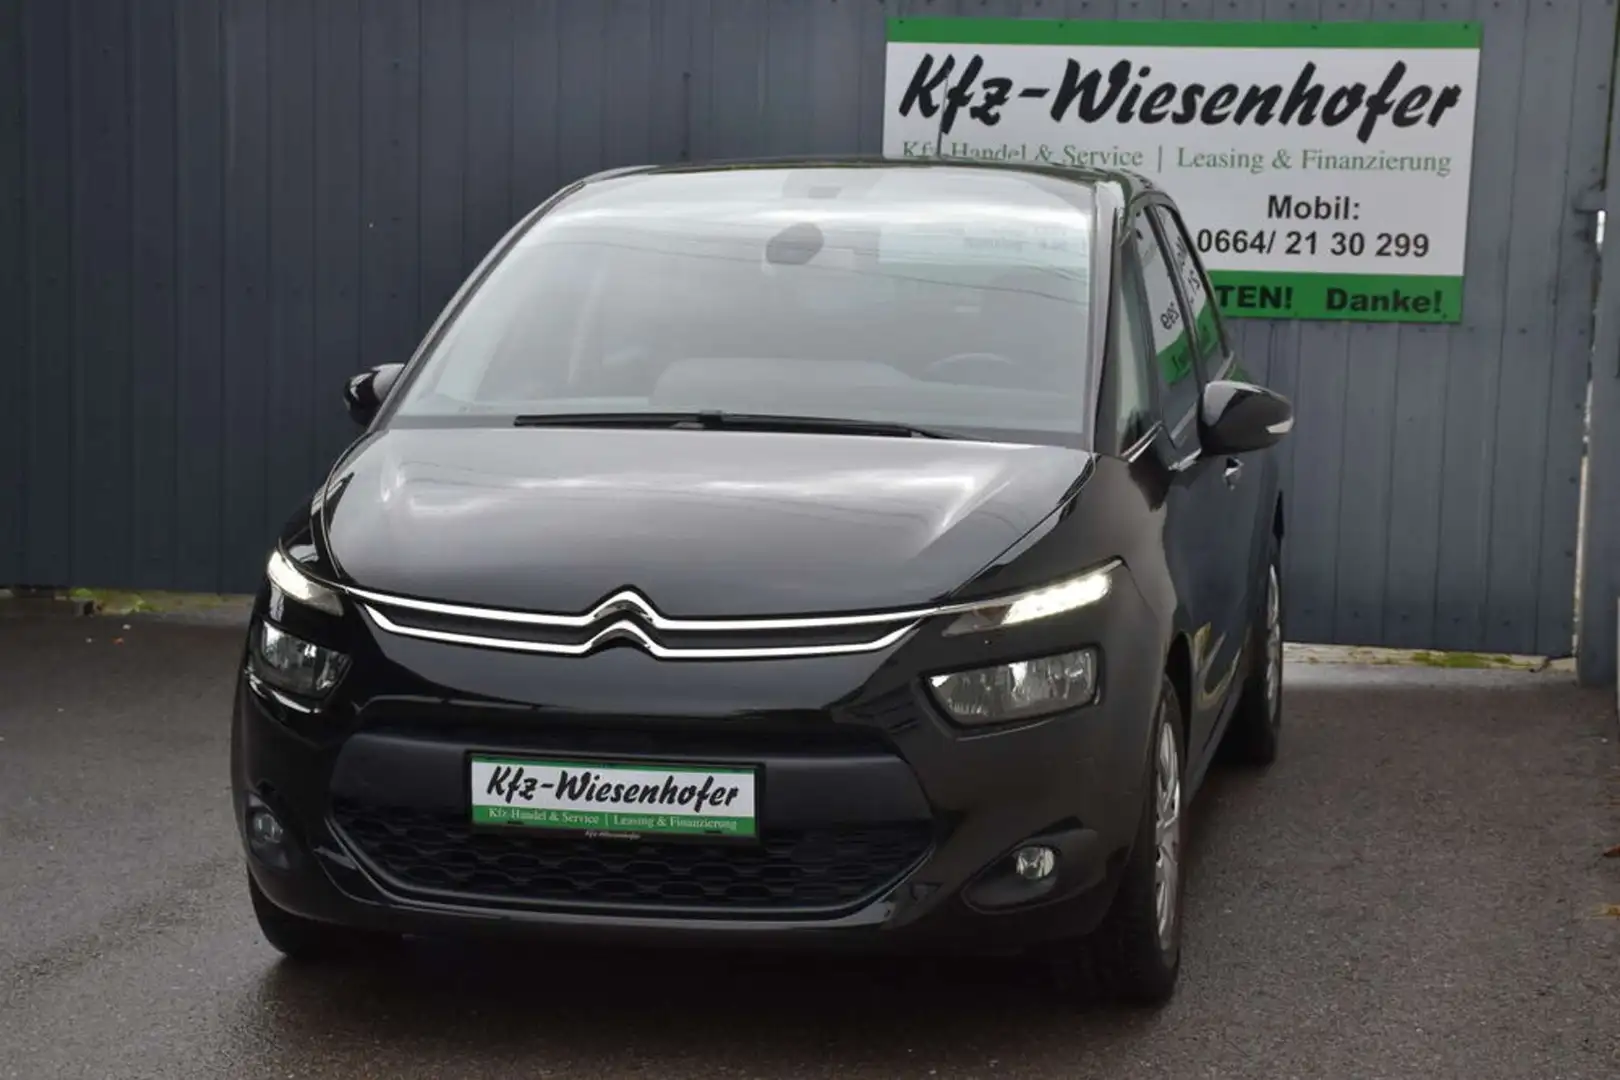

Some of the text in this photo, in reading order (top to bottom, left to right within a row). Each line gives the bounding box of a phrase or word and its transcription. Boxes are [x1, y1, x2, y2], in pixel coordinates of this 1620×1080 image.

[898, 52, 1461, 144] Kfz-Wiesenhofer
[1034, 144, 1054, 163] &
[1062, 144, 1143, 167] Service
[1177, 147, 1264, 175] Leasing
[1271, 148, 1292, 170] &
[1301, 149, 1452, 177] Finanzierung
[1267, 194, 1361, 220] Mobil:
[1197, 229, 1430, 257] 0664/ 21 30 299
[1326, 287, 1444, 314] Danke!
[486, 765, 739, 813] Kfz-Wiesenhofer
[562, 811, 600, 825] Service
[613, 814, 654, 829] Leasing
[656, 815, 667, 827] &
[670, 815, 738, 832] Finanzierung
